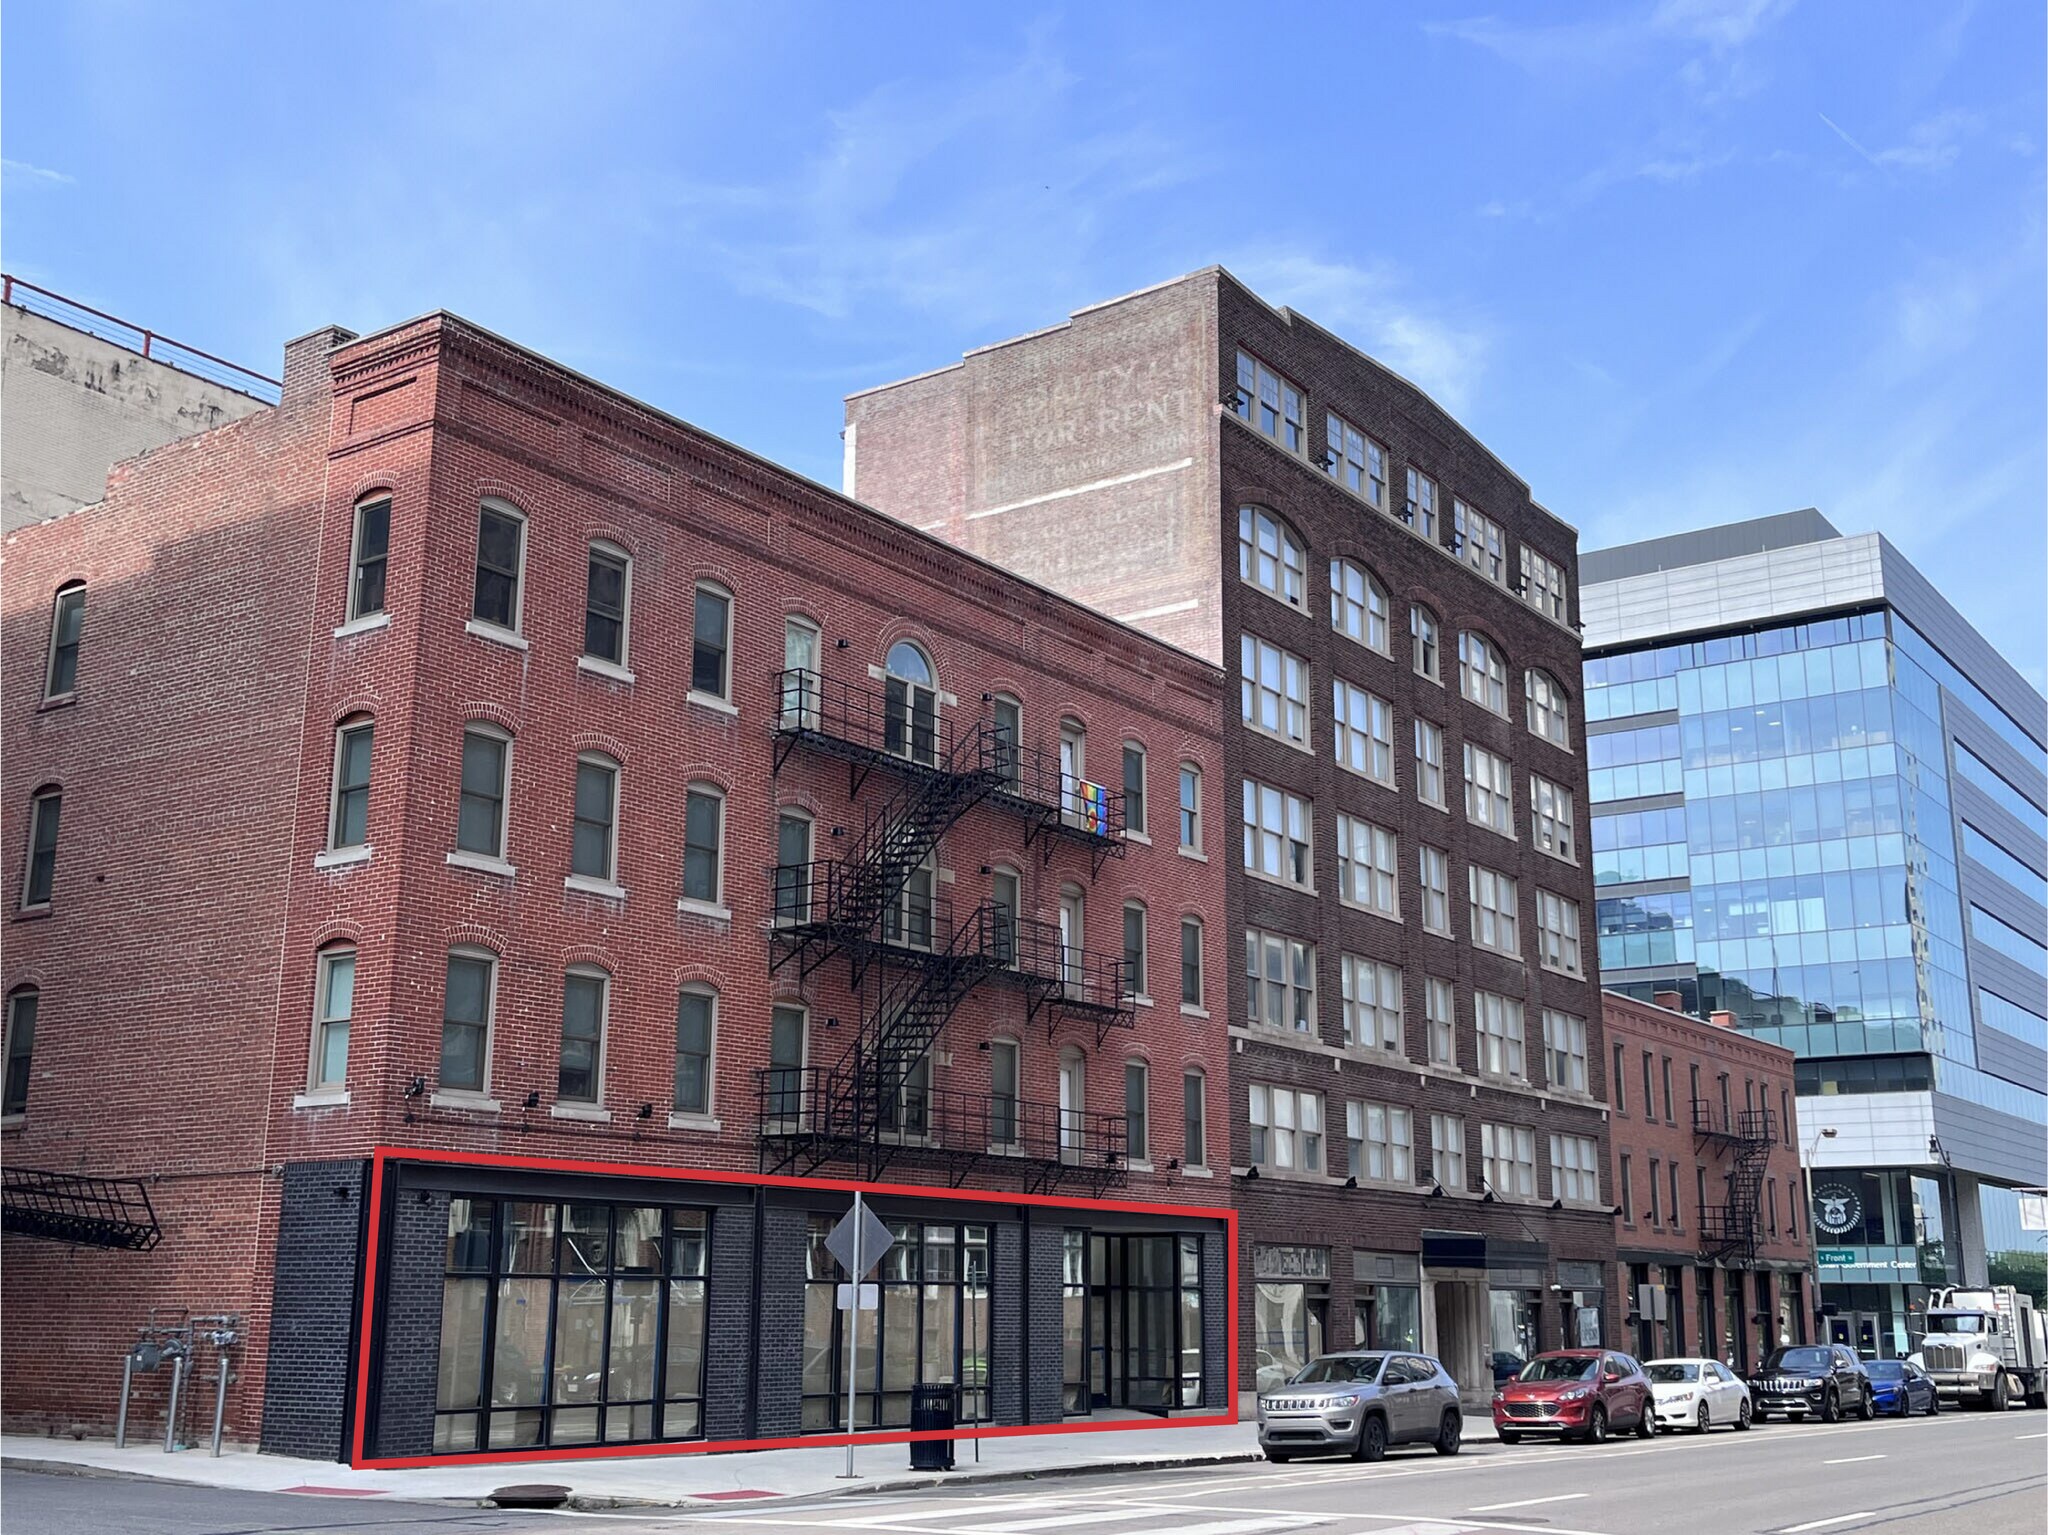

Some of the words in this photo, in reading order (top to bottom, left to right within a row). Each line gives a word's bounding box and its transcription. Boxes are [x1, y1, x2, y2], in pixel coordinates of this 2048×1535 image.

[1097, 387, 1193, 433] RENT
[1825, 1253, 1846, 1262] Front
[1890, 1260, 1916, 1268] Center
